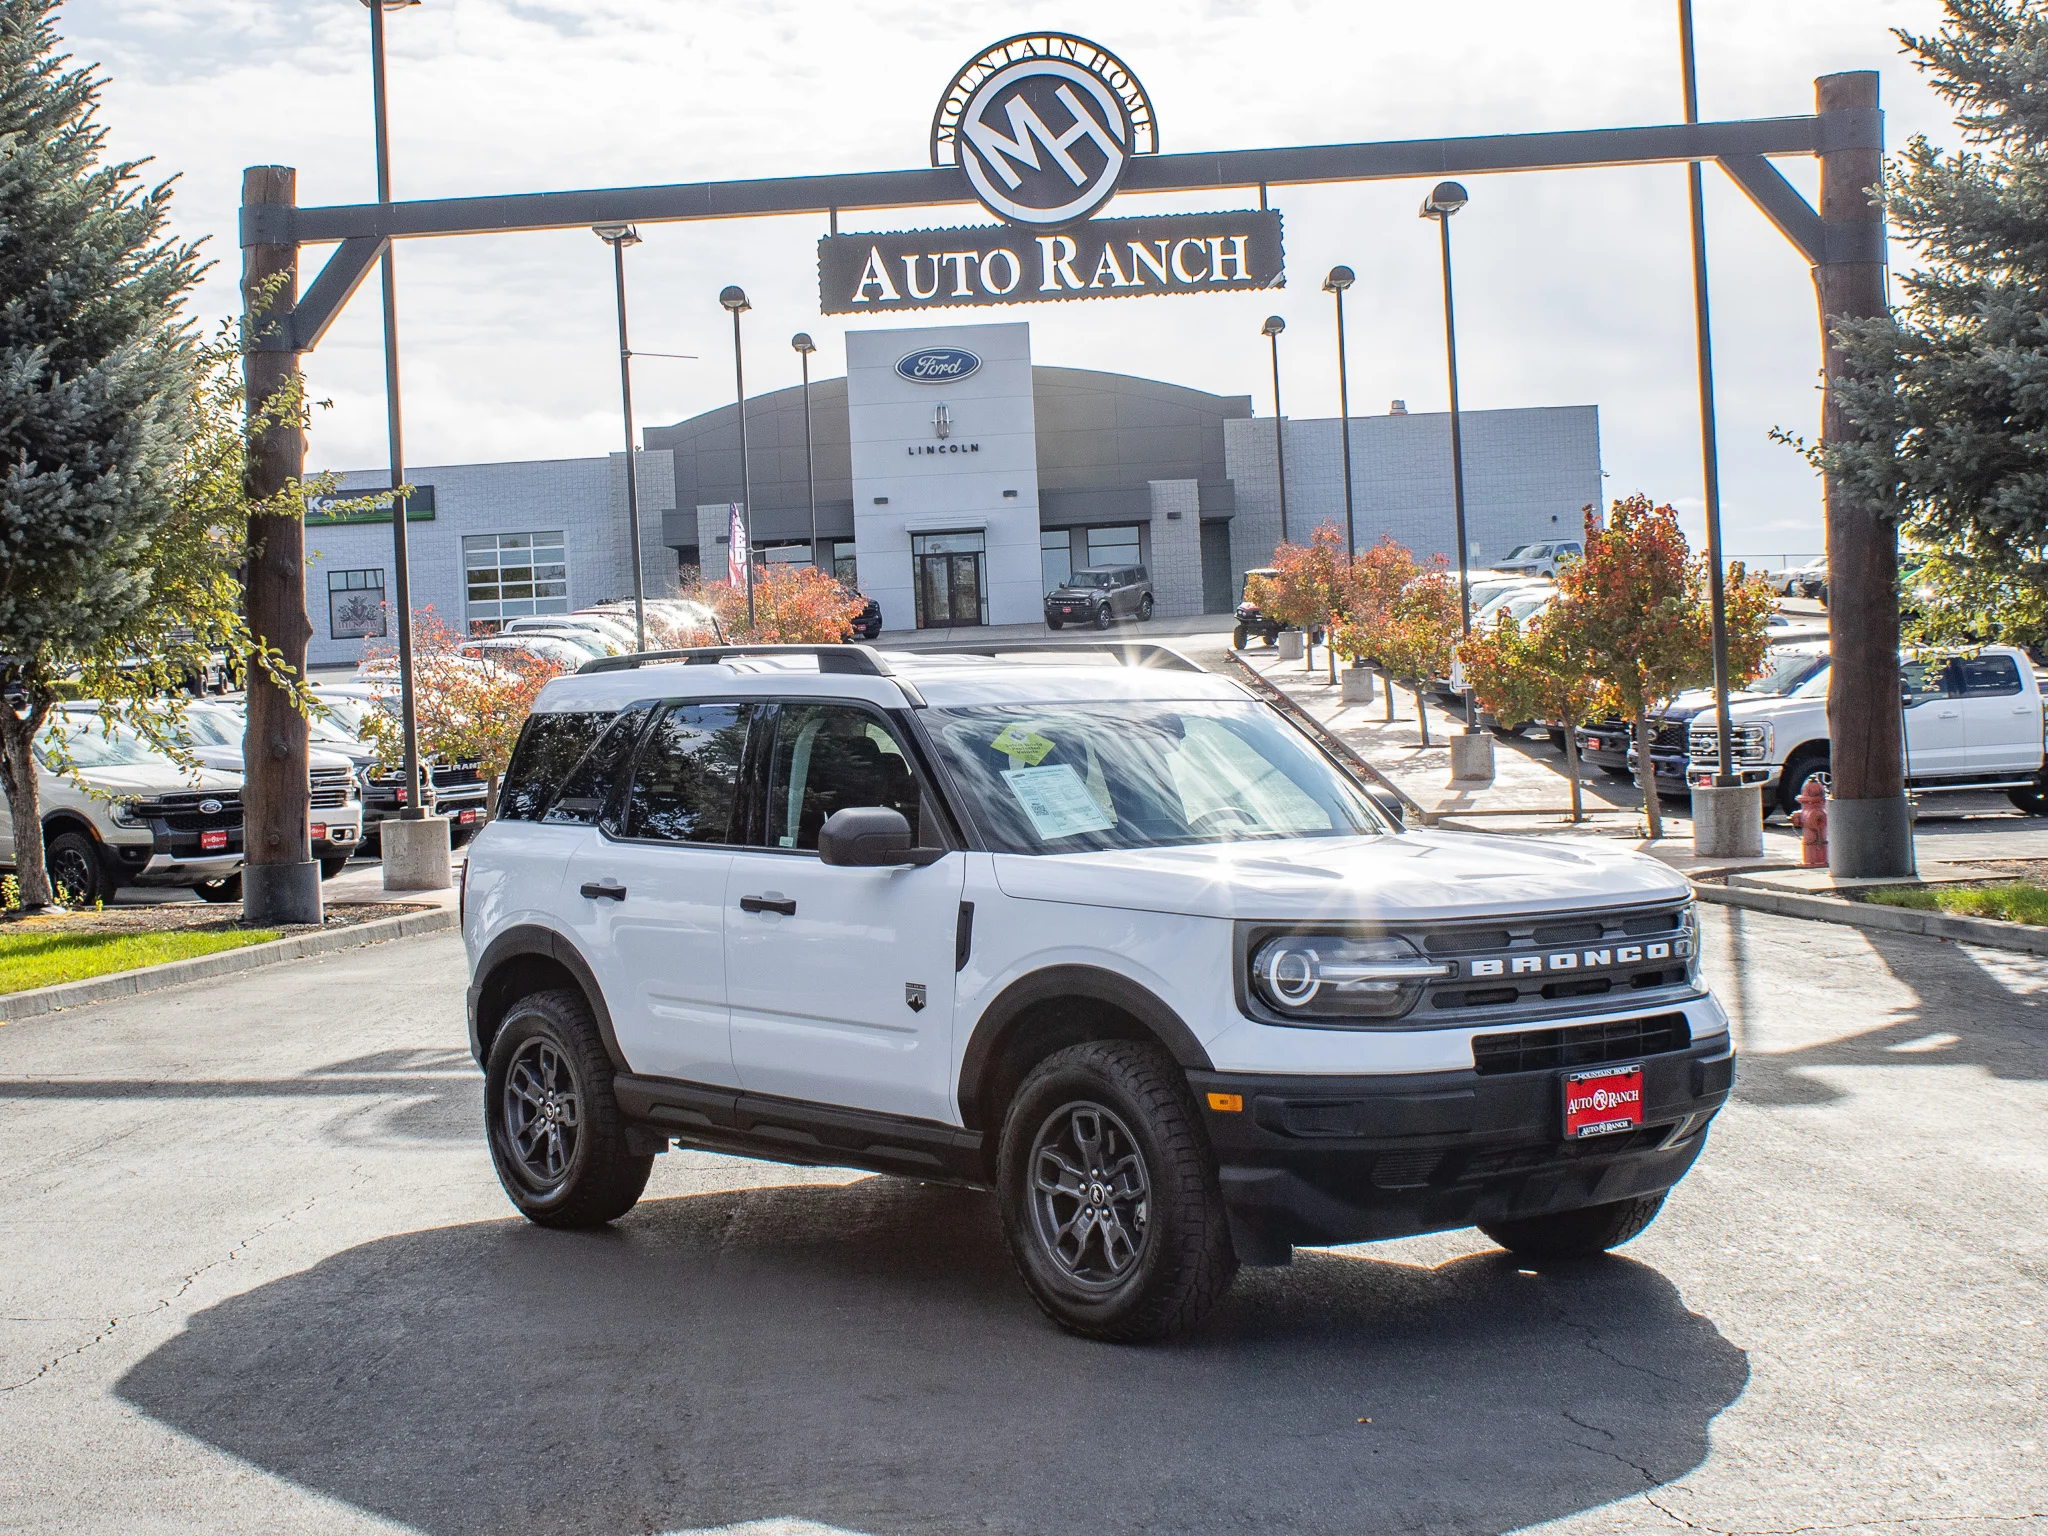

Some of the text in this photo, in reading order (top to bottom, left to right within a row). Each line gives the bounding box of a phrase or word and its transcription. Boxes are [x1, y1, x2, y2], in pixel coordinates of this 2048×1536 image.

[937, 38, 1151, 143] MOUNTAIN HOME
[962, 83, 1124, 191] MH
[851, 234, 1253, 303] AUTO RANCH
[913, 354, 962, 377] Ford
[908, 443, 979, 456] LINCOLN
[1471, 943, 1669, 976] BRONCO
[1567, 1097, 1593, 1115] AUTO
[1608, 1090, 1639, 1108] RANCH
[1581, 1127, 1599, 1136] AUTO
[1607, 1121, 1628, 1131] RANCH
